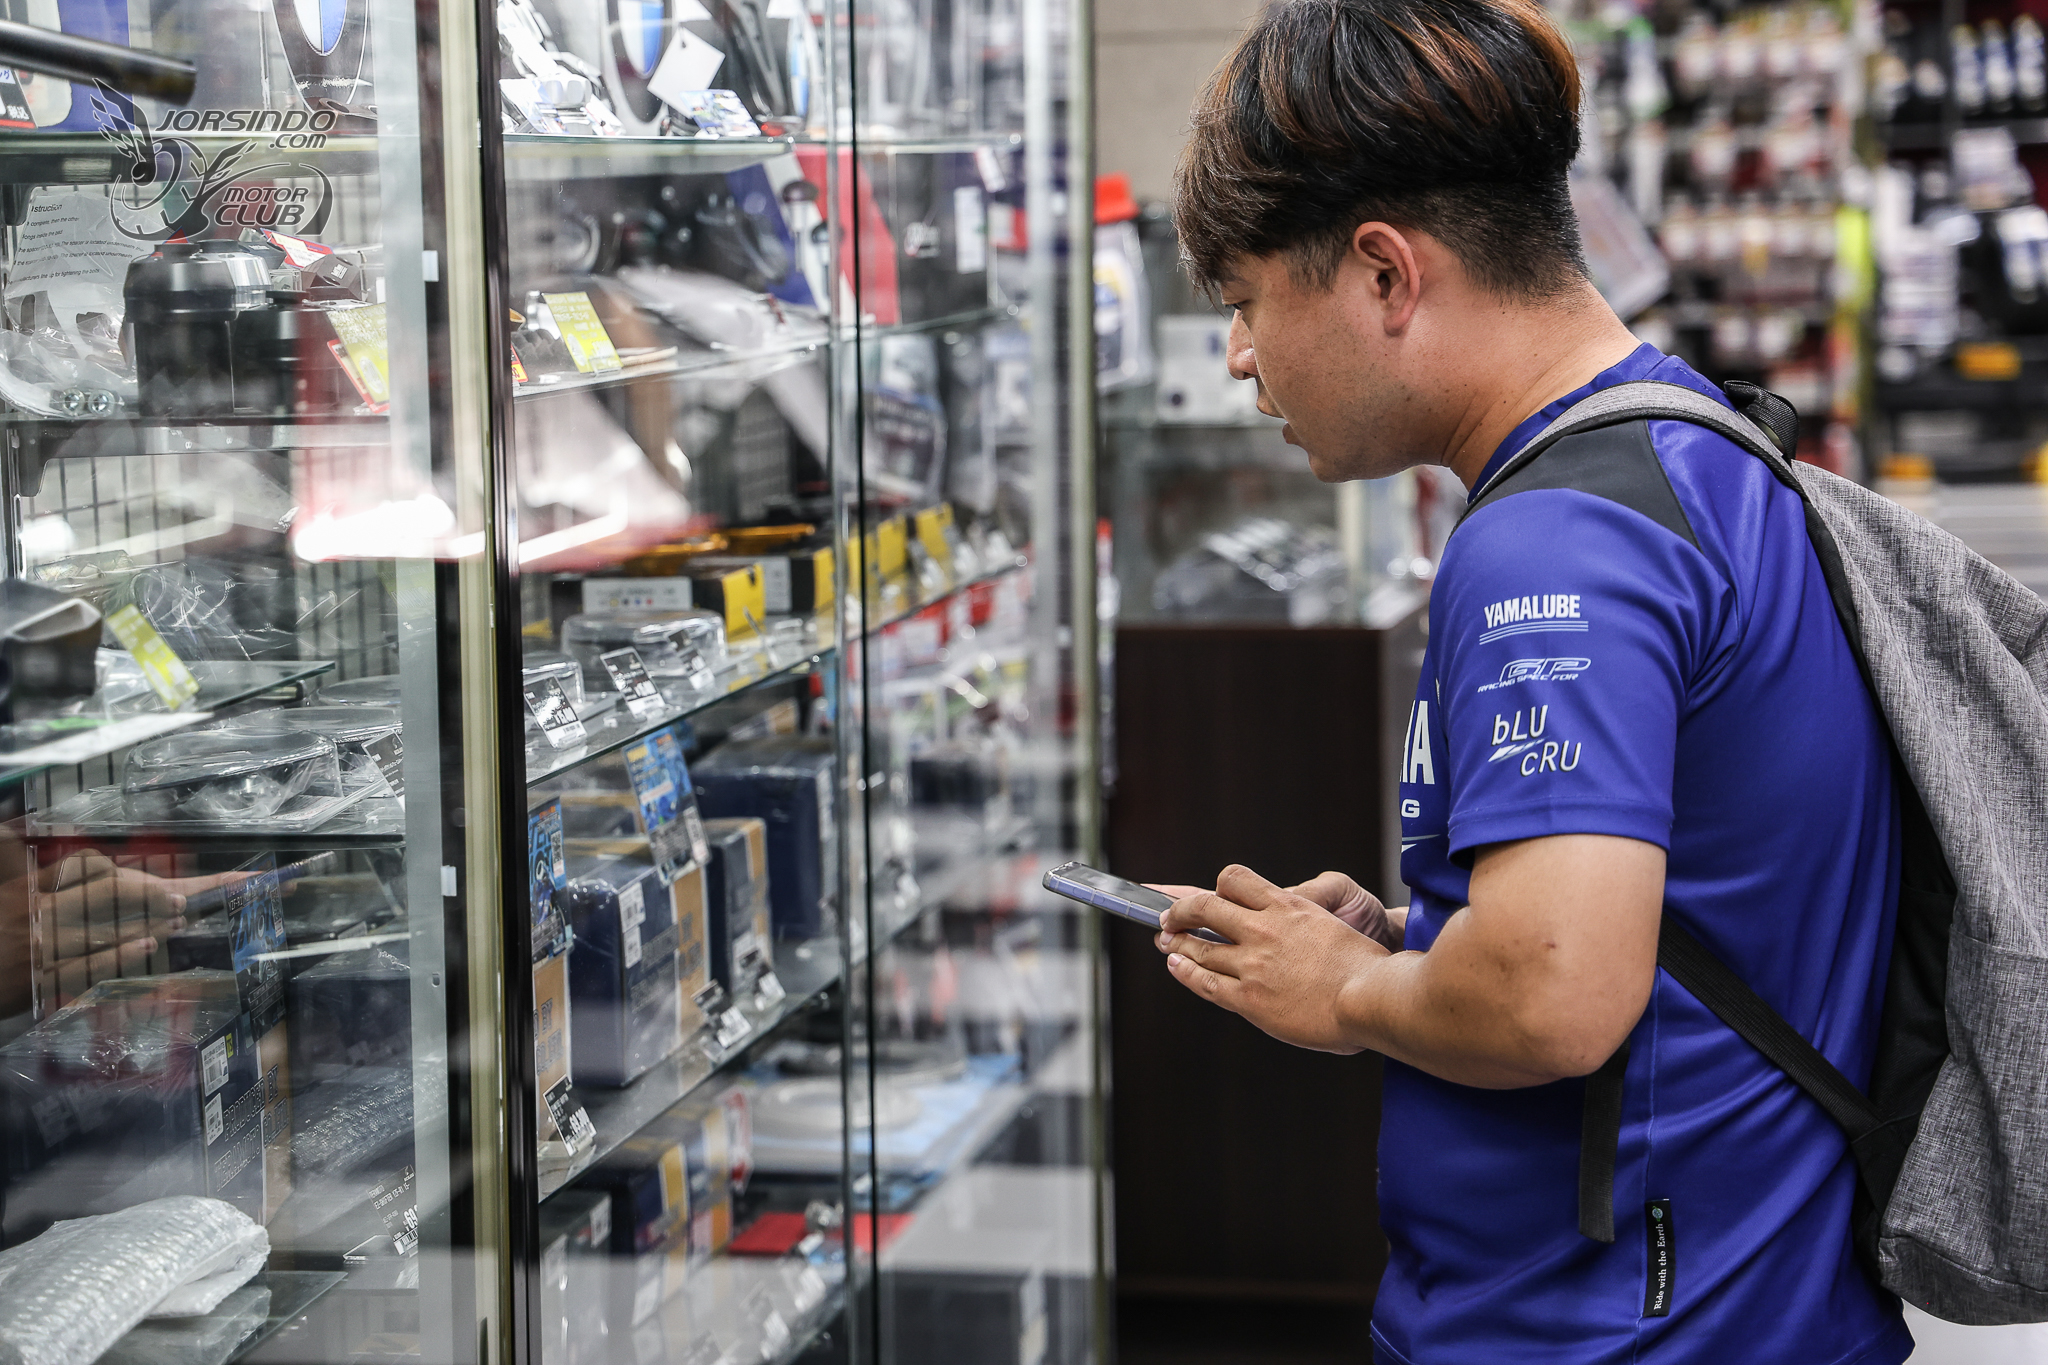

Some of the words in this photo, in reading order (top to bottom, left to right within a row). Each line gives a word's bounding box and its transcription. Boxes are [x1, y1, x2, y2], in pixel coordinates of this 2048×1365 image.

[1484, 594, 1581, 629] YAMALUBE
[1477, 678, 1516, 693] RACING
[1516, 673, 1549, 683] SPEC
[1551, 673, 1579, 682] FOR
[1656, 1223, 1665, 1247] Earth
[1658, 1250, 1667, 1267] the
[1658, 1269, 1667, 1289] with
[1653, 1290, 1665, 1310] Ride
